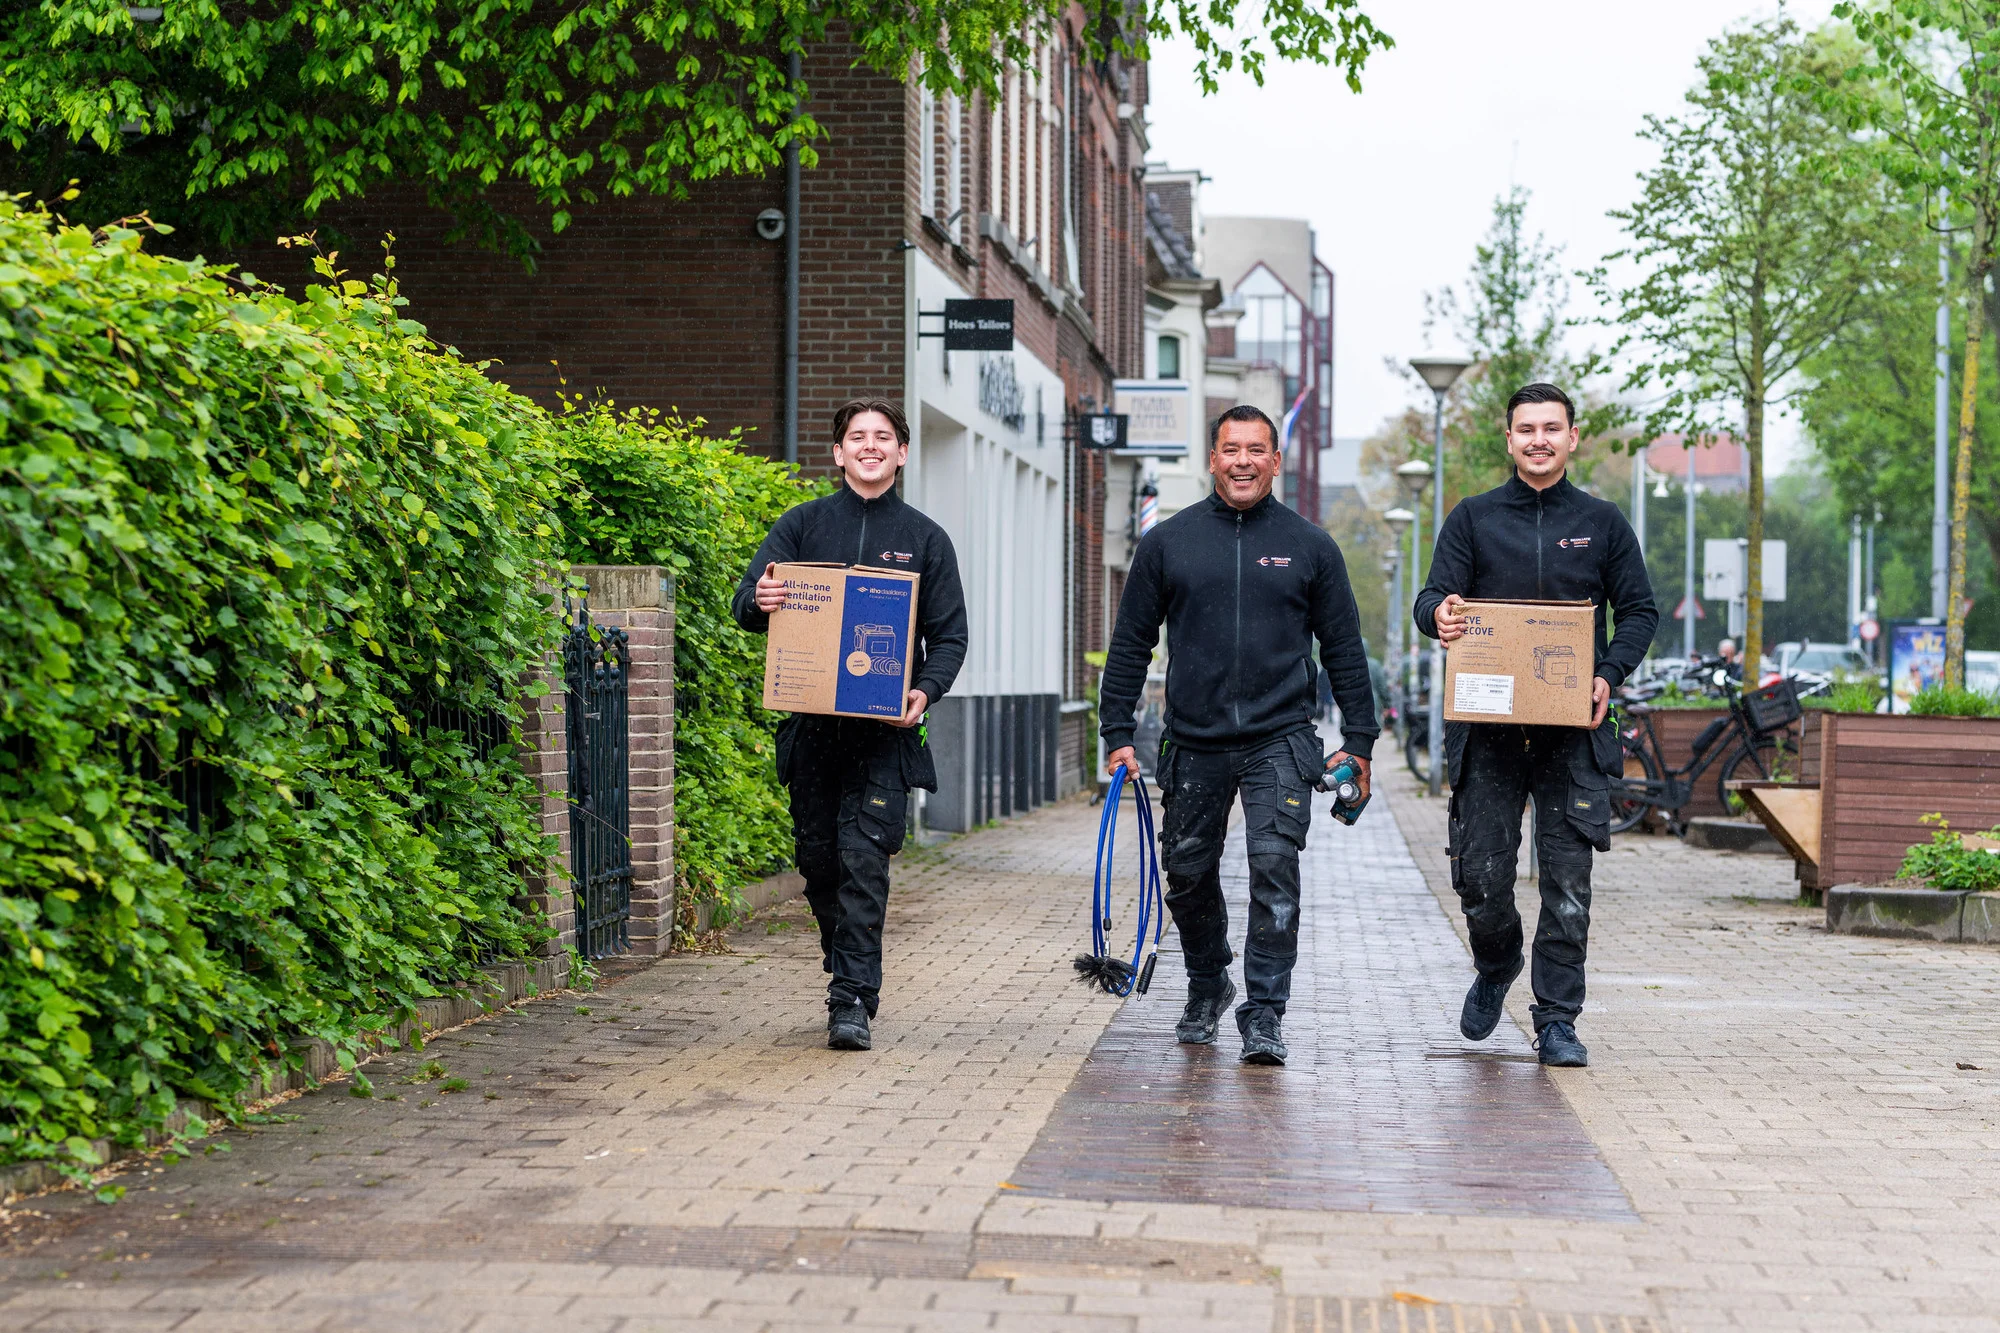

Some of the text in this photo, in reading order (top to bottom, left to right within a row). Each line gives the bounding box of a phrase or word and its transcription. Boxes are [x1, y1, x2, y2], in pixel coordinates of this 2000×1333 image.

[783, 580, 831, 591] All-in-one
[781, 602, 820, 613] package
[1464, 616, 1481, 625] CVE
[1463, 626, 1494, 636] ECOVE
